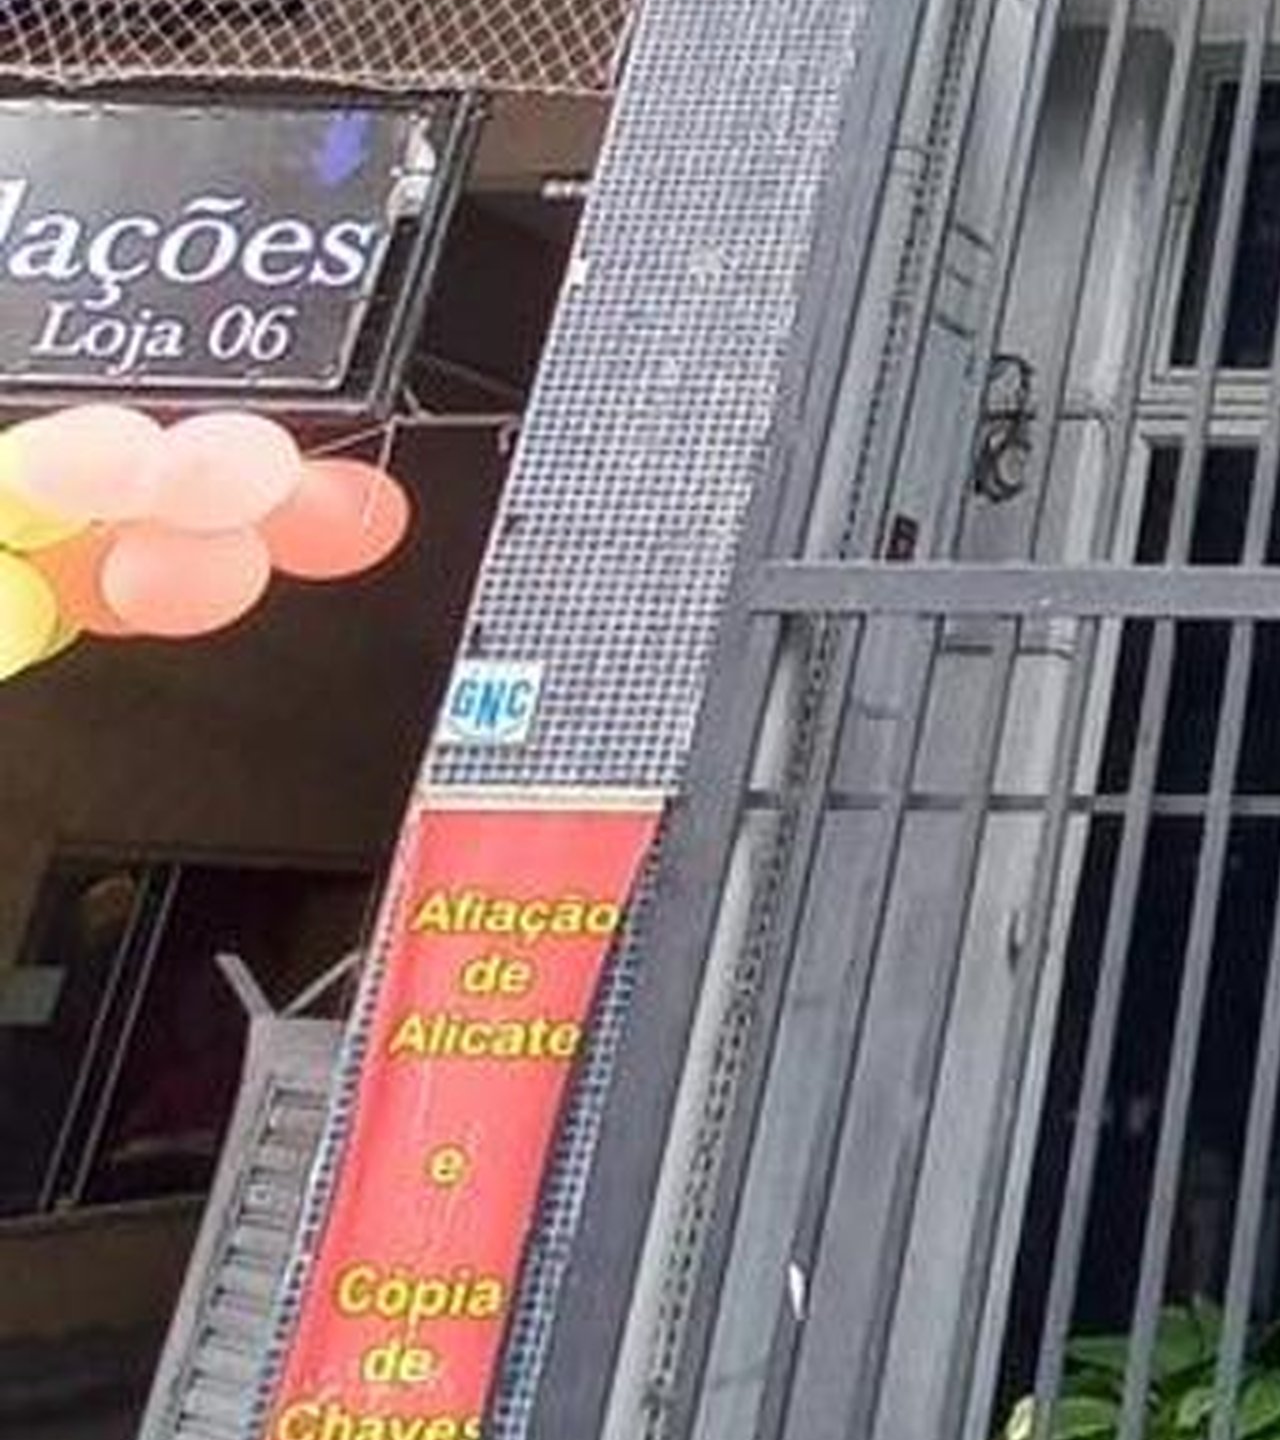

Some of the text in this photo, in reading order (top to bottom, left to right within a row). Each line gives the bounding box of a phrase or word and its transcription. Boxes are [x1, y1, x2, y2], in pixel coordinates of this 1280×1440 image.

[29, 299, 297, 375] Loja 06
[449, 677, 534, 729] GNC
[411, 889, 620, 945] Afiação
[462, 954, 532, 994] de
[390, 1012, 582, 1057] Alicate
[430, 1145, 465, 1183] e
[362, 1336, 436, 1383] de
